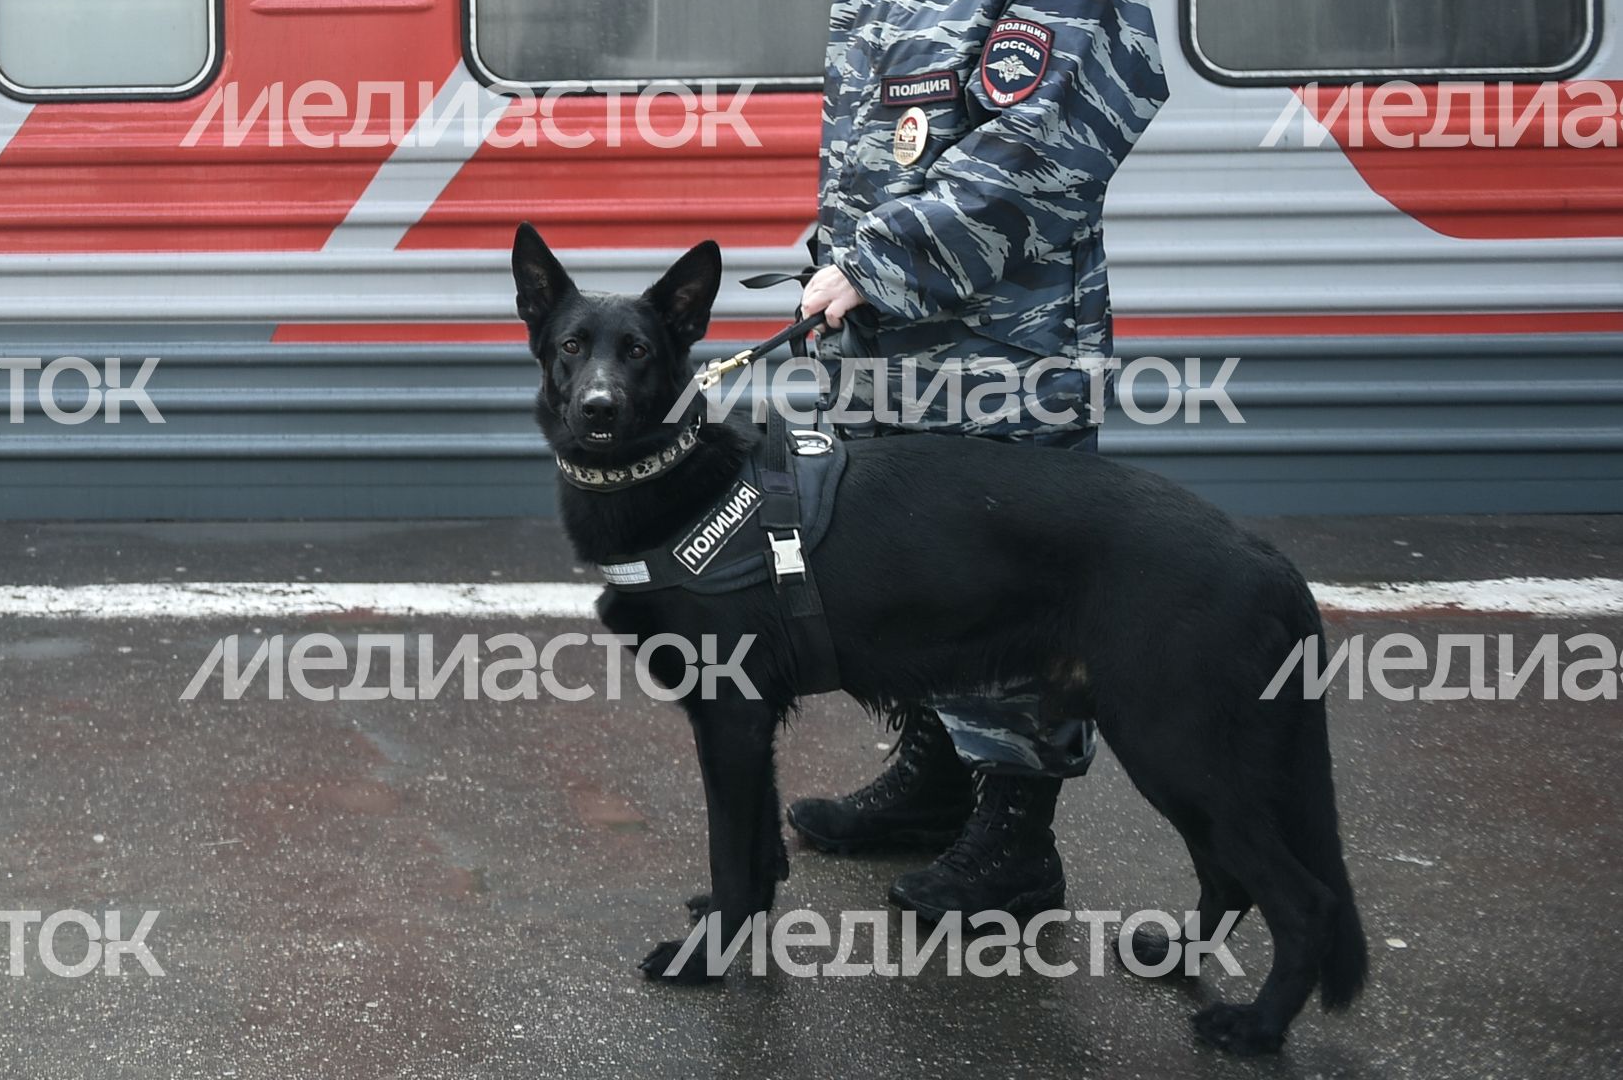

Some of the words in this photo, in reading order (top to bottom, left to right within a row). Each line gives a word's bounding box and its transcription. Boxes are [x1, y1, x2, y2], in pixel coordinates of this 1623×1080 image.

[996, 22, 1047, 42] ПОЛИЦИЯ
[992, 41, 1040, 60] РОССИЯ
[889, 79, 950, 97] ПОЛИЦИЯ
[991, 89, 1014, 104] МВД
[681, 486, 757, 566] ПОЛИЦИЯ
